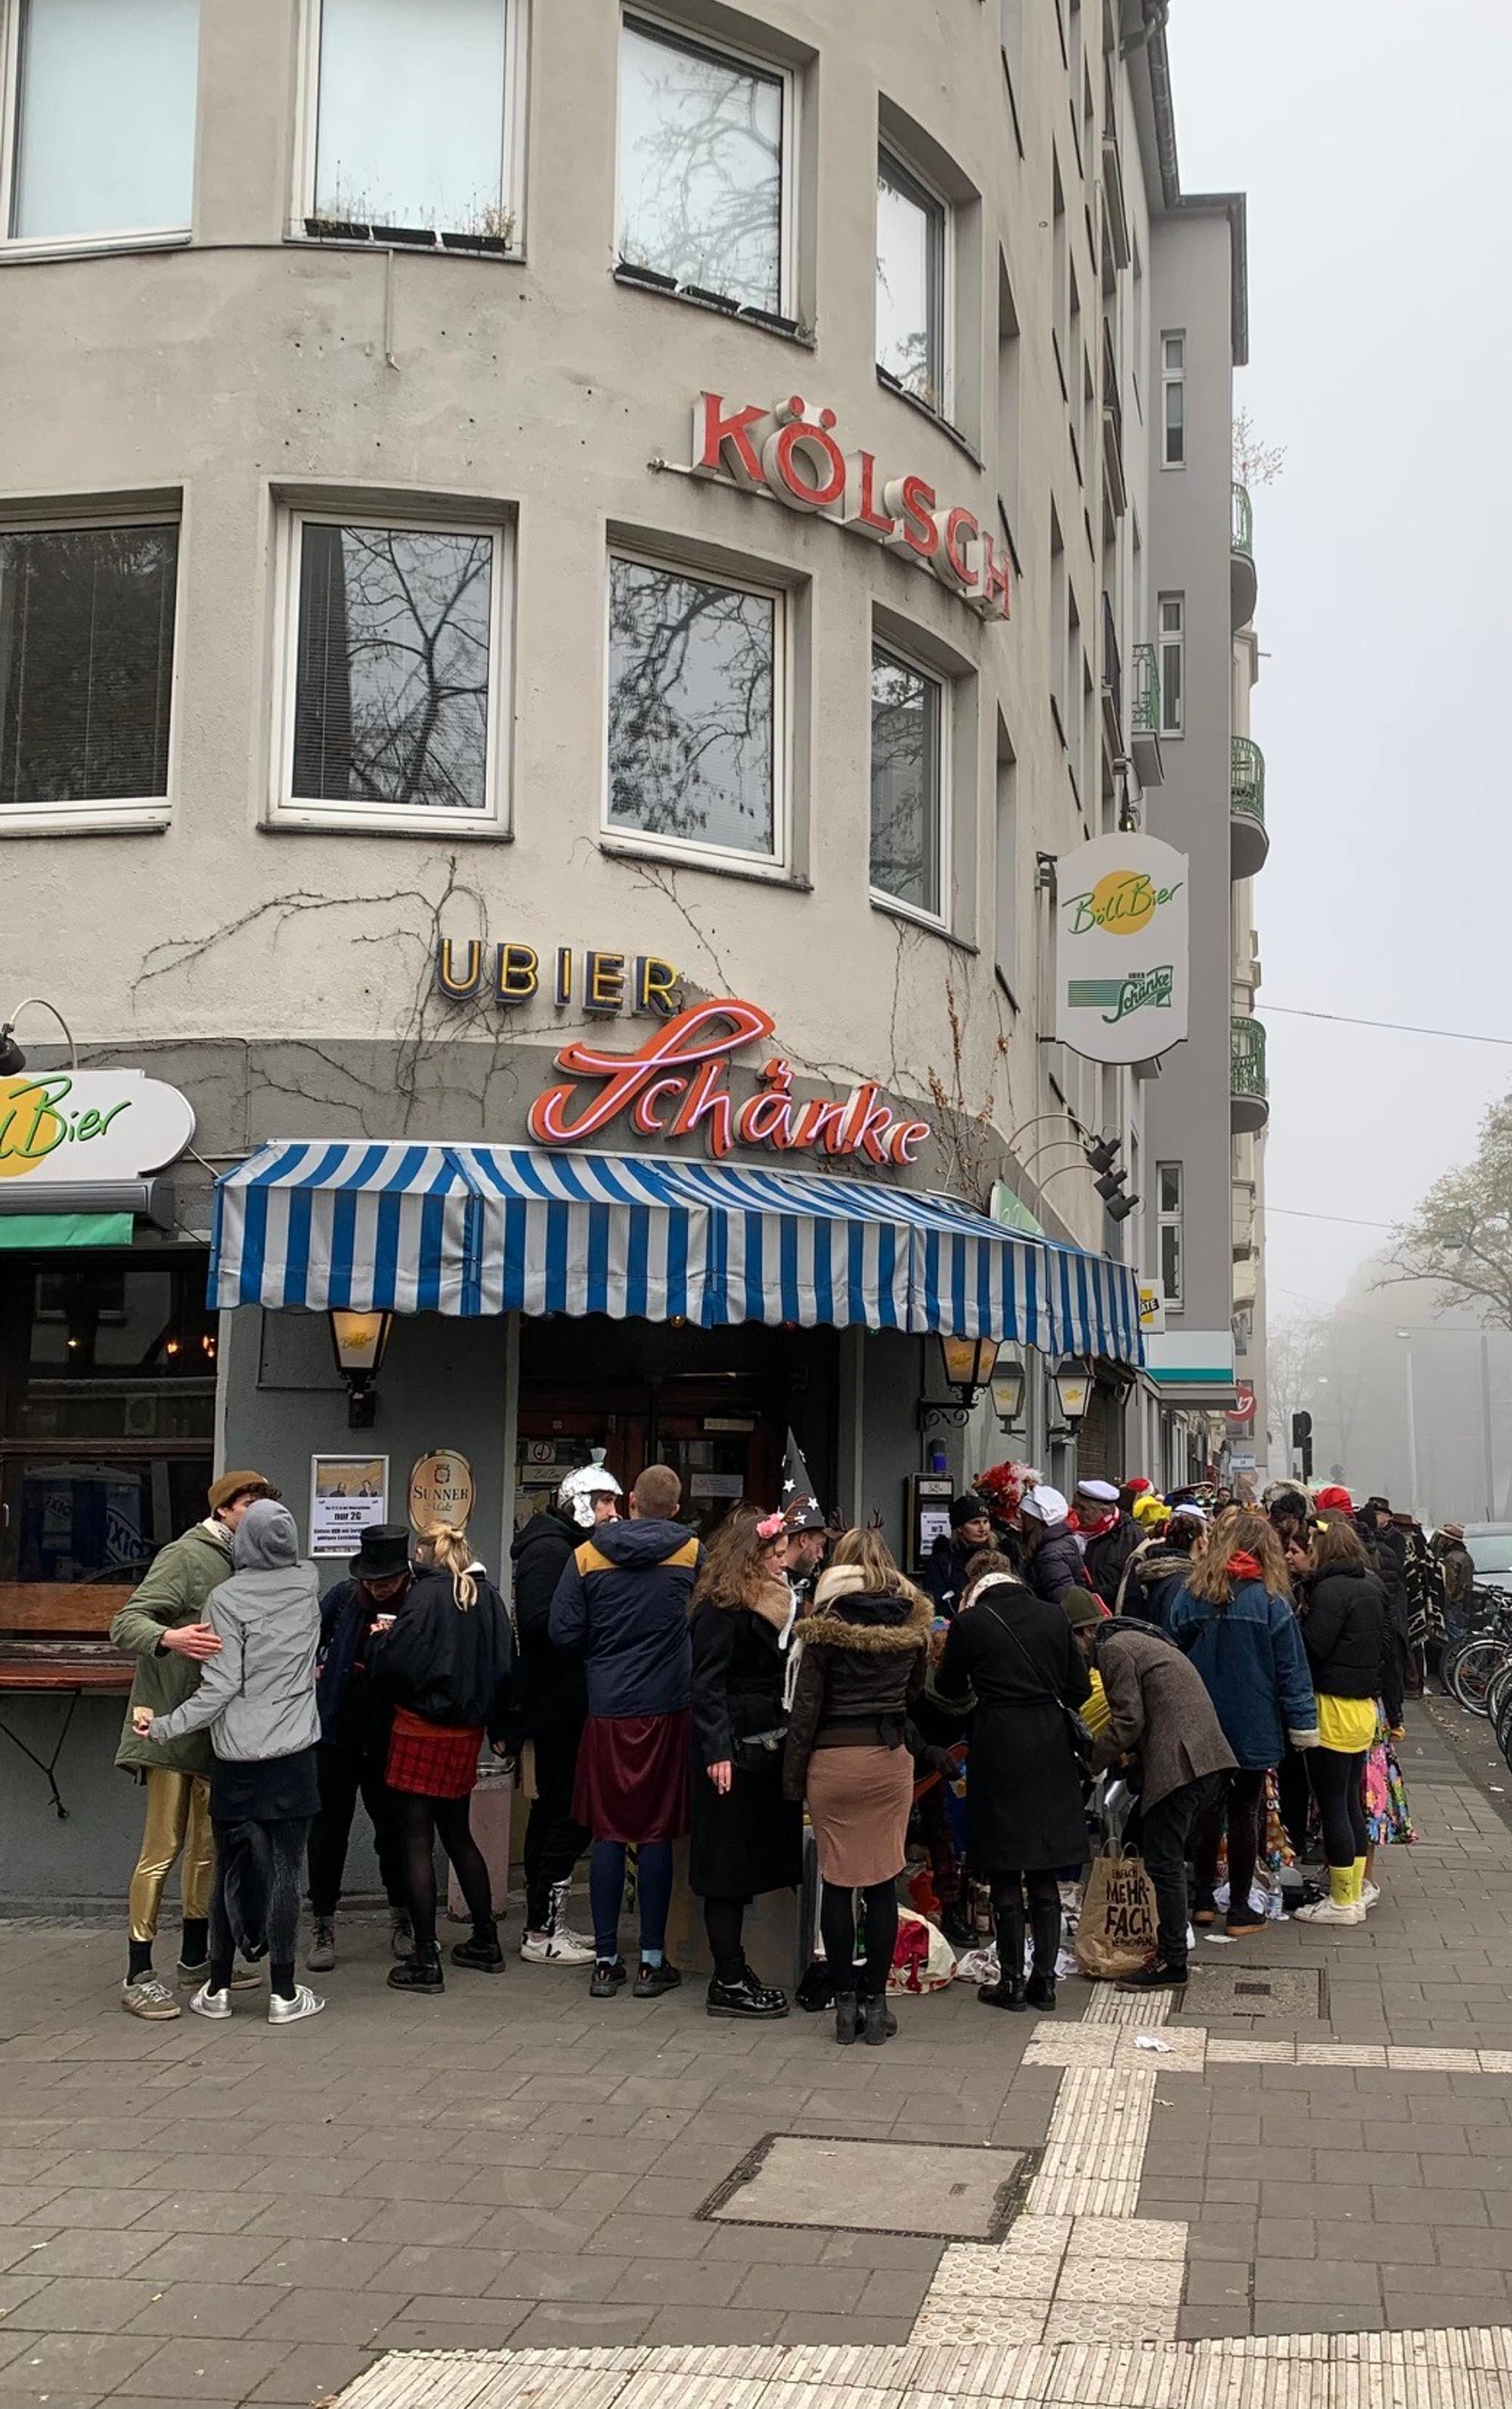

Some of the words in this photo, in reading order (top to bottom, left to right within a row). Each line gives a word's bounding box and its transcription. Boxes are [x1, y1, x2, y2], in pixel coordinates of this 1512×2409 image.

[692, 391, 1011, 622] KÖLSCH
[1061, 891, 1125, 935] Böll
[1118, 874, 1184, 917] Bier
[437, 937, 681, 1015] UBIER
[1101, 969, 1170, 1024] Schänke
[9, 1075, 132, 1158] Bier
[528, 998, 931, 1166] Schänke
[1104, 1905, 1153, 1937] FACH
